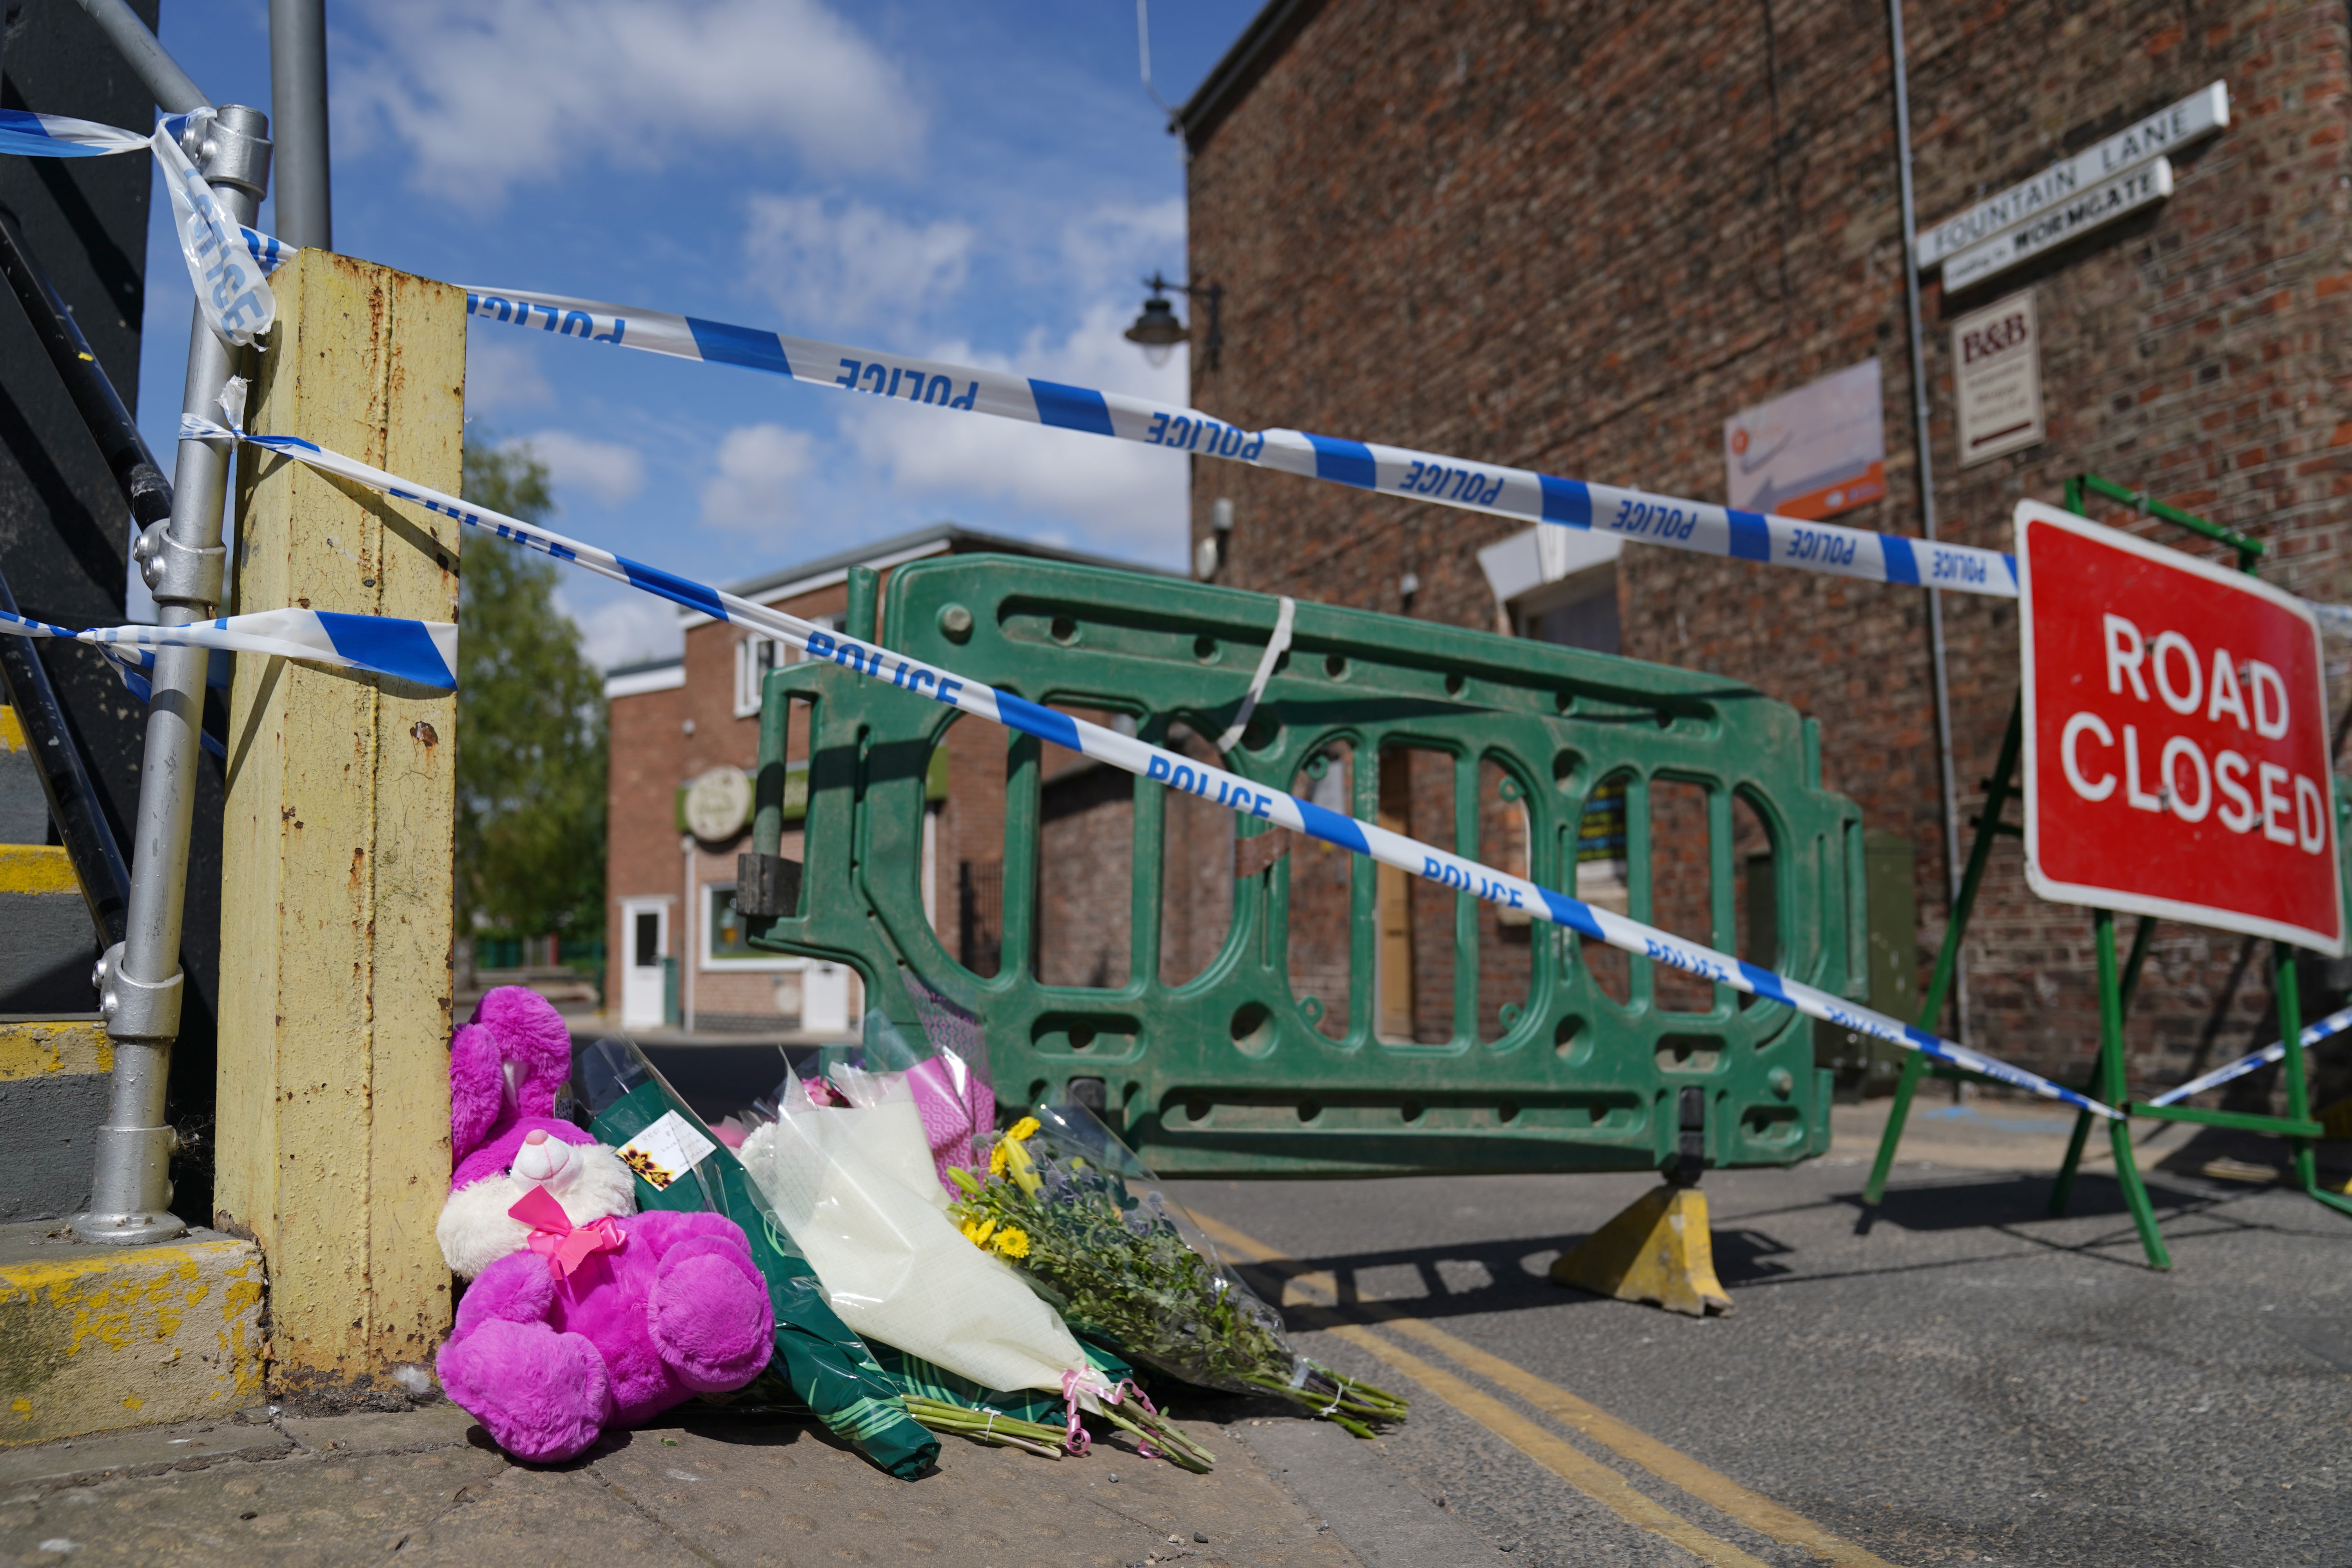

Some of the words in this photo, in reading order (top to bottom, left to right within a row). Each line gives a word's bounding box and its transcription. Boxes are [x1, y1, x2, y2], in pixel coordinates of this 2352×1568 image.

[1935, 165, 2078, 251] FOUNTAIN
[2102, 107, 2190, 171] LANE
[2014, 172, 2154, 256] WORMGATE
[1964, 314, 2026, 364] B&B
[835, 350, 979, 411] POLICE
[1143, 412, 1265, 461] POLICE
[1398, 460, 1504, 506] POLICE
[1610, 499, 1698, 541] POLICE
[1786, 529, 1857, 566] POLICE
[1932, 551, 1986, 584] POLICE
[2103, 613, 2290, 740] ROAD
[2060, 711, 2326, 855] CLOSED
